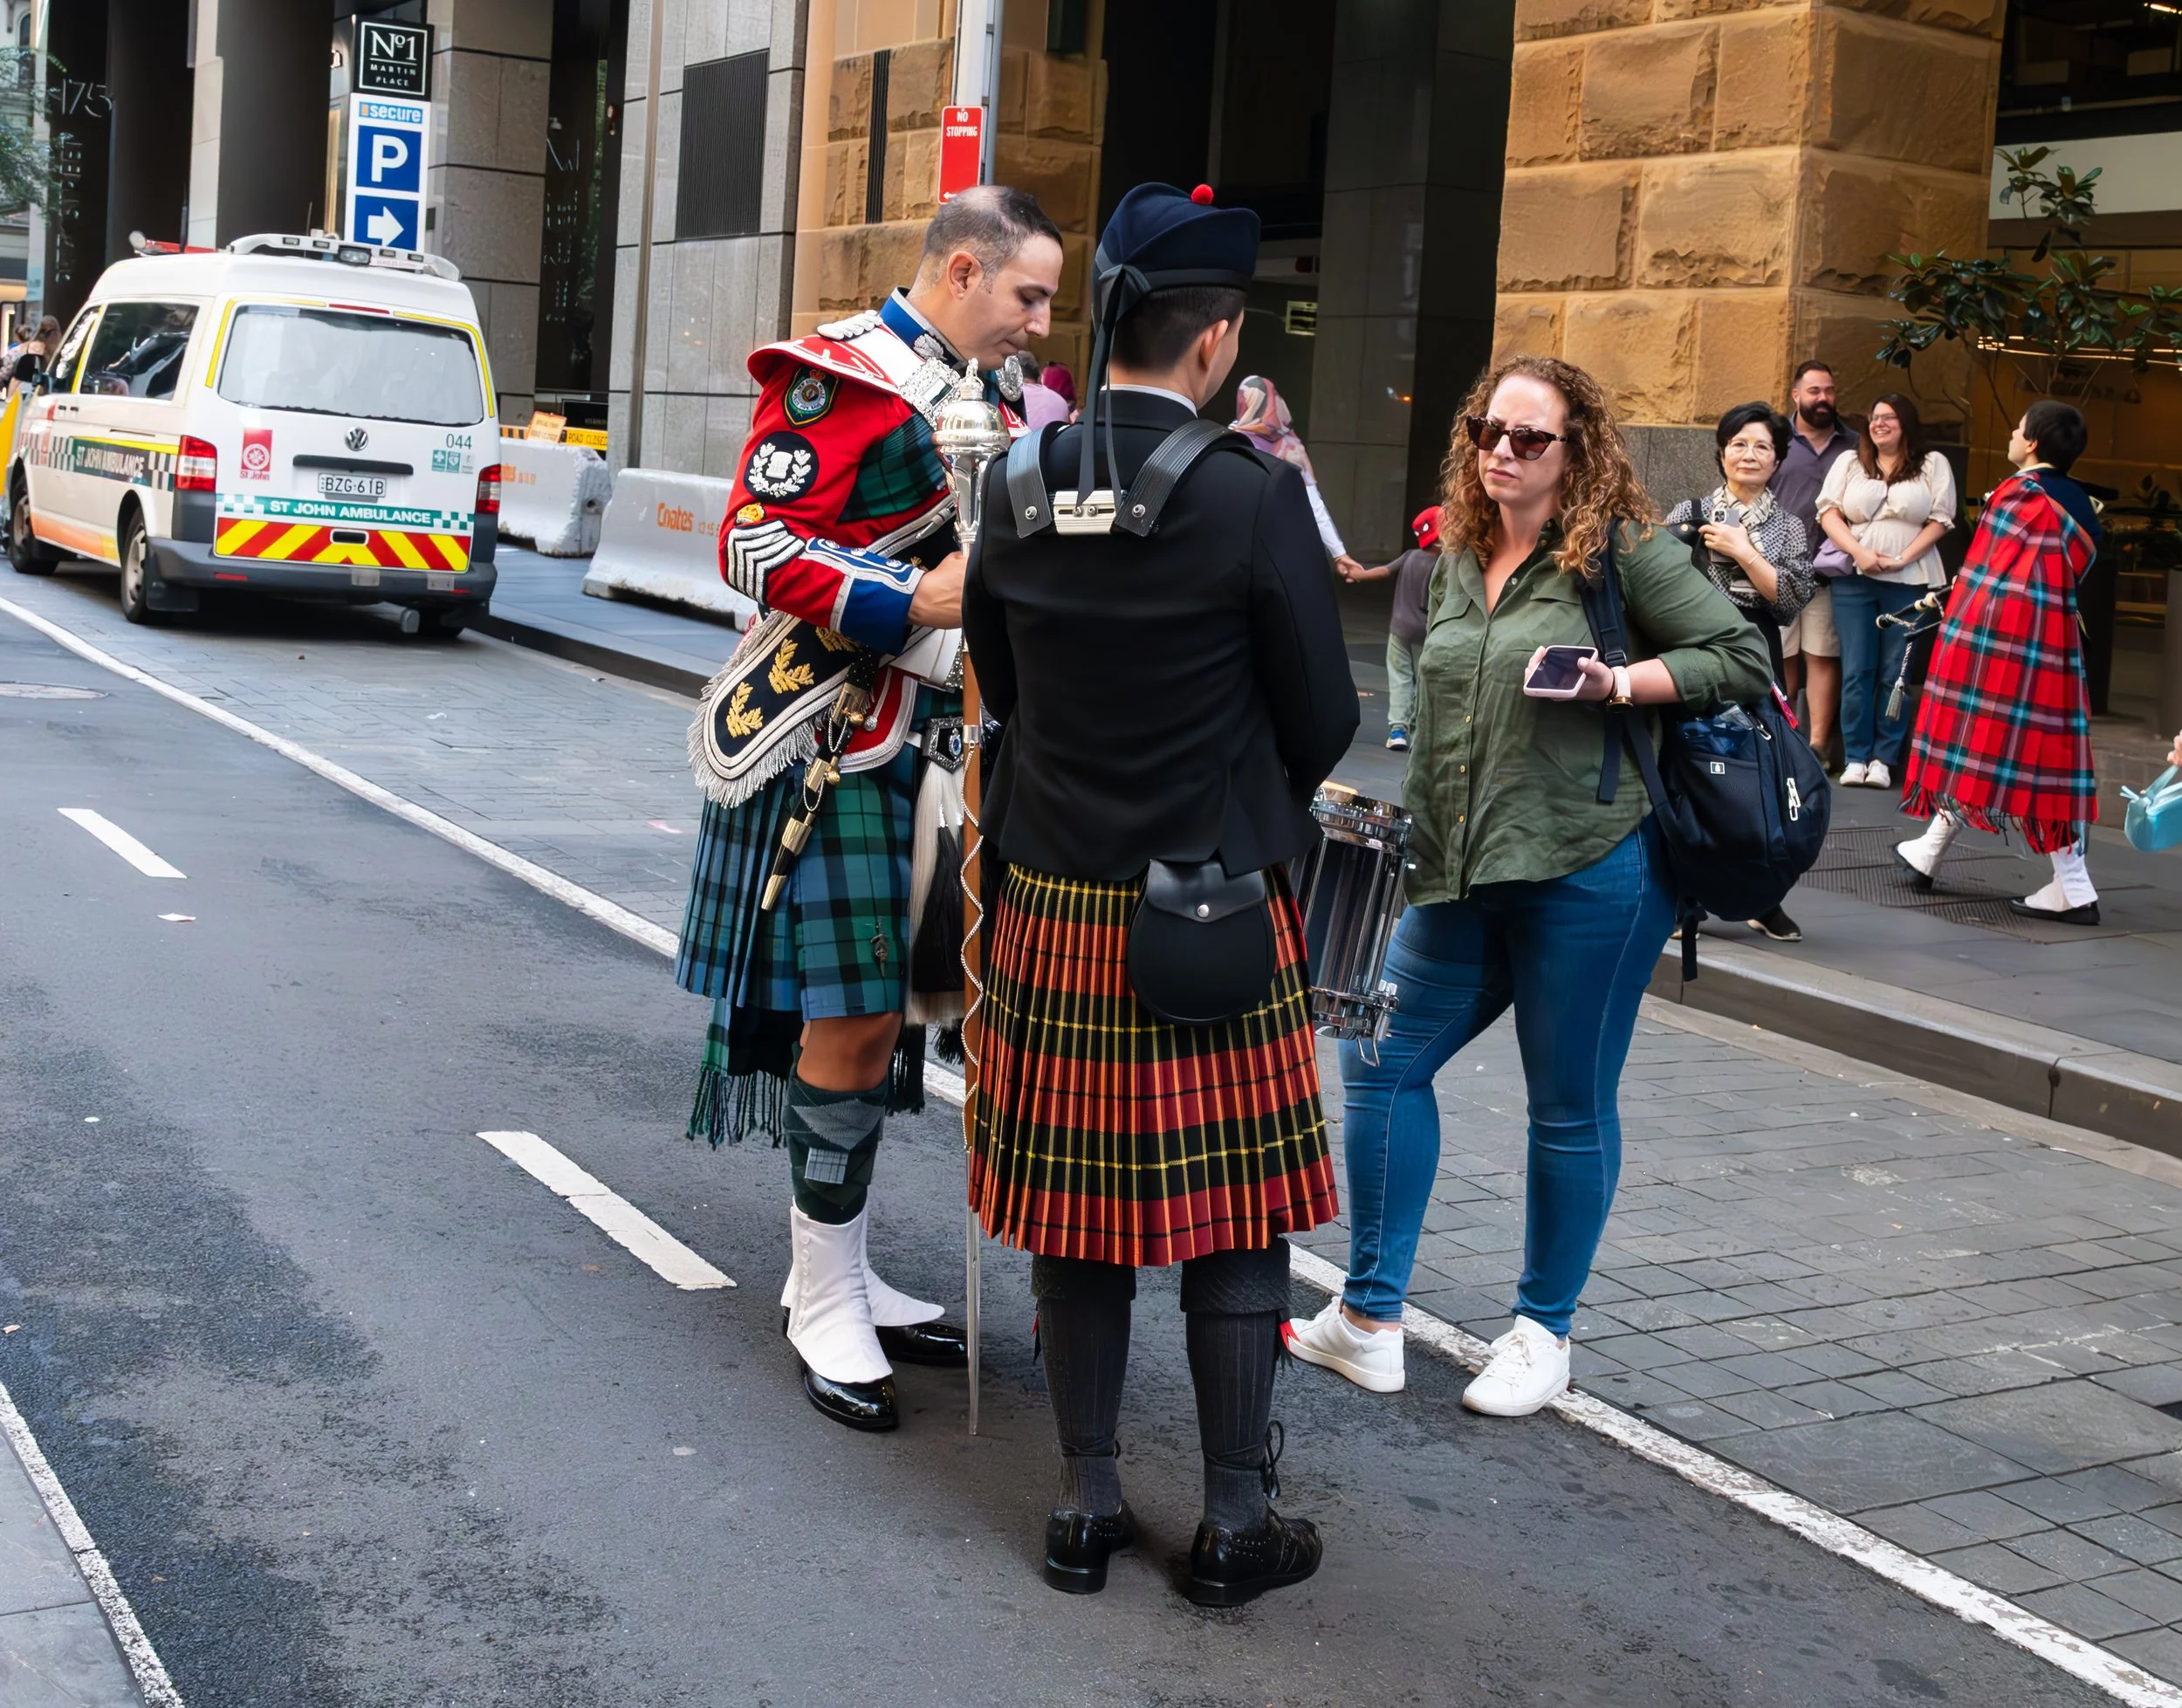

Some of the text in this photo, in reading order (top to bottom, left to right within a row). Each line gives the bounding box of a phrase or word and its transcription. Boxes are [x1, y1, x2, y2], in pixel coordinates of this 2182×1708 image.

[370, 64, 416, 75] MARTIN
[375, 76, 409, 86] PLACE
[369, 105, 422, 122] secure
[957, 111, 969, 122] NO
[946, 126, 978, 137] STOPPING
[371, 134, 408, 182] P
[446, 433, 472, 449] 044
[76, 445, 146, 478] ST JOHN AMBULANCE
[240, 470, 270, 481] St John
[270, 500, 431, 524] ST JOHN AMBULANCE
[657, 502, 694, 532] Coates
